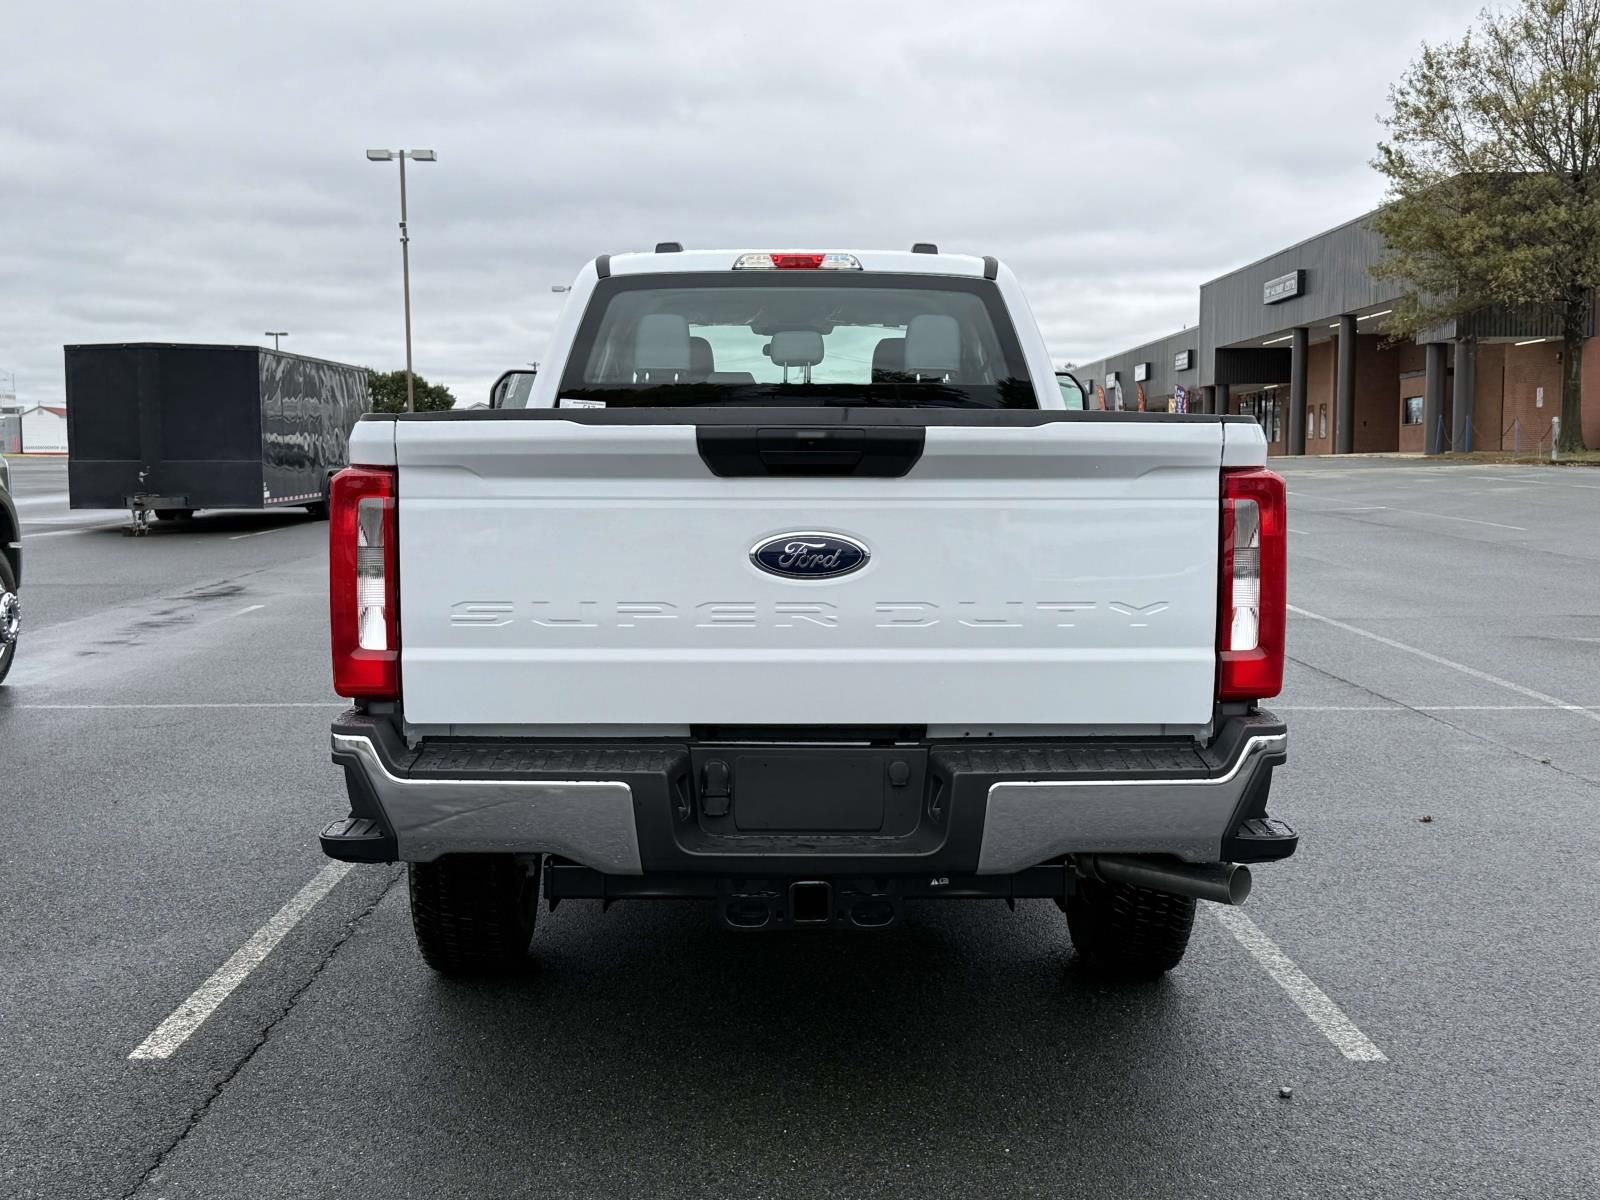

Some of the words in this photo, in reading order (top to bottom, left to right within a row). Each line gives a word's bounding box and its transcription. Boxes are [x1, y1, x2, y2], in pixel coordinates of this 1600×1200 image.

[779, 541, 842, 568] Ford
[450, 601, 838, 628] SUPER
[875, 601, 1169, 628] DUTY
